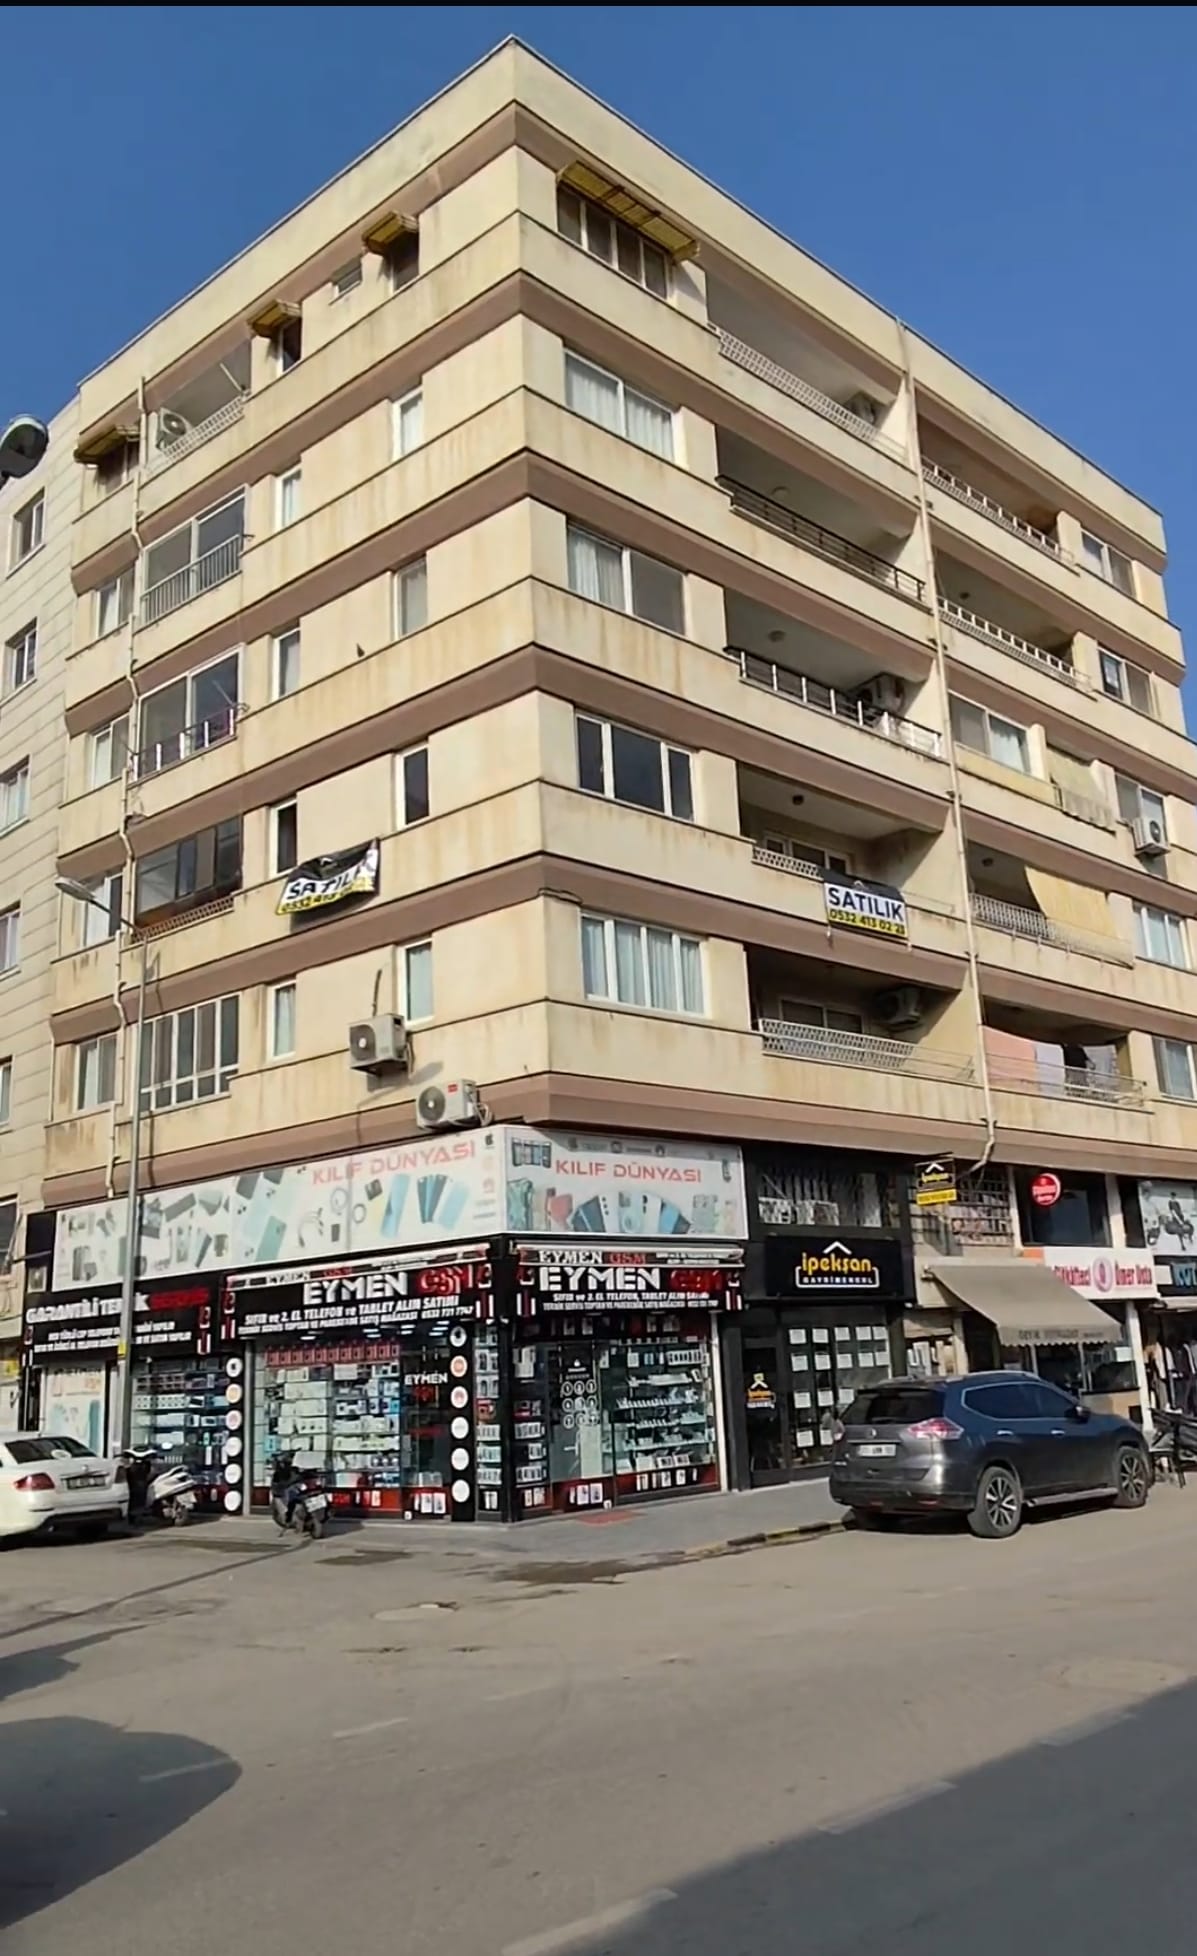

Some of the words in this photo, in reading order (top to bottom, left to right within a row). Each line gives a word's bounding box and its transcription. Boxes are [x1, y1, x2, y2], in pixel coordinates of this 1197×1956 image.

[828, 887, 904, 922] SATILIK
[313, 1161, 363, 1185] KILIF
[370, 1140, 475, 1175] DÜNYASI
[555, 1159, 606, 1176] KILIF
[613, 1161, 702, 1183] DÜNYASI
[539, 1250, 602, 1265] EYMEN
[802, 1252, 871, 1276] ipekşan
[303, 1271, 408, 1306] EYMEN
[539, 1267, 661, 1292] EYMEN
[304, 1306, 343, 1320] TELEFON
[359, 1301, 394, 1315] TABLET
[404, 1371, 448, 1386] EYMEN
